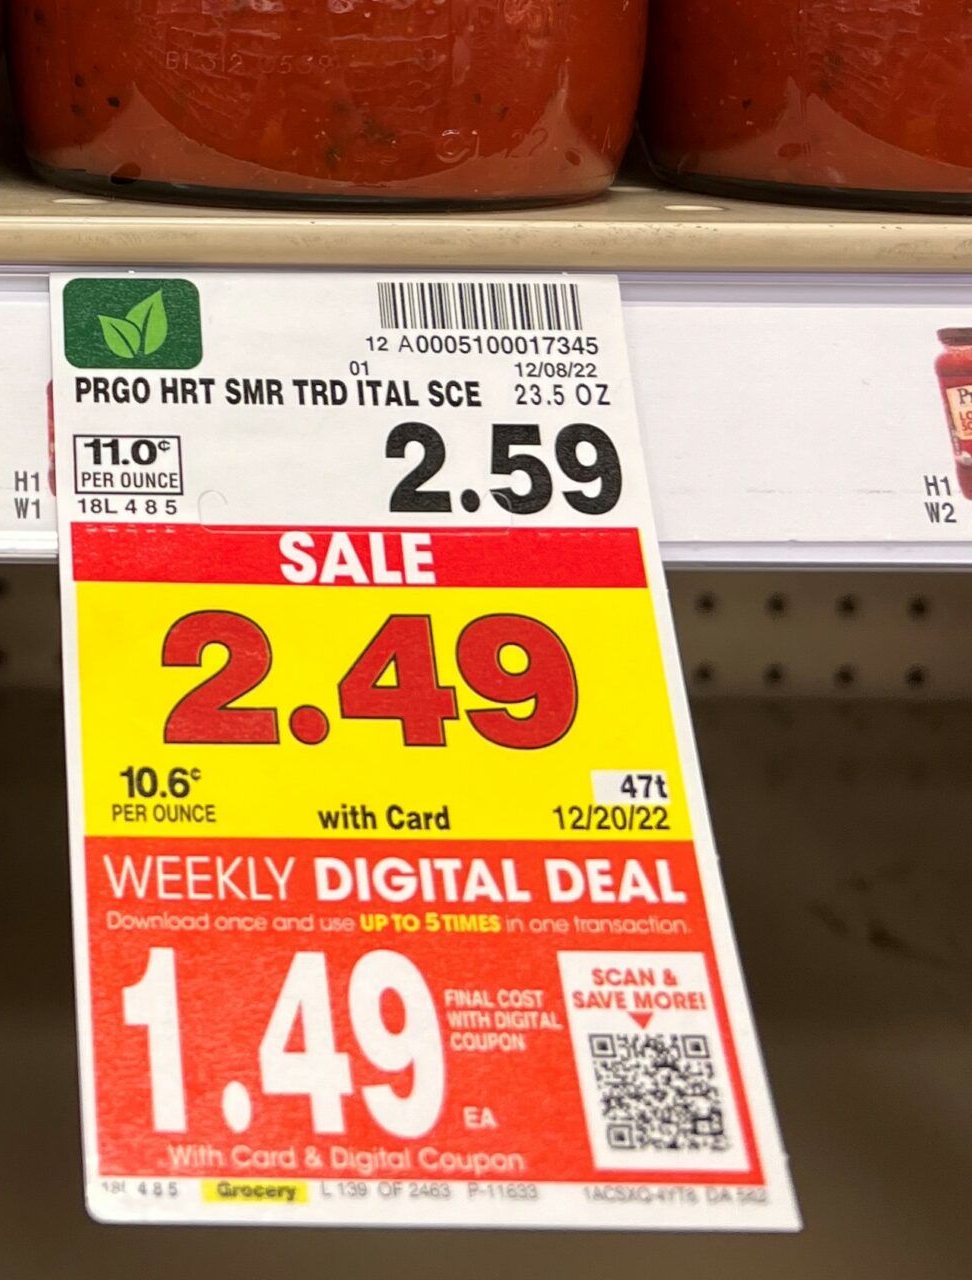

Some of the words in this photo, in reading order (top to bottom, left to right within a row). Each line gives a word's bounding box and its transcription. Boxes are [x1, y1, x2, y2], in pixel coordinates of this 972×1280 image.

[365, 337, 389, 353] 12
[397, 335, 599, 355] A0005100017345
[348, 361, 371, 377] 01
[513, 362, 598, 379] 12/08/22
[75, 377, 151, 405] PRGO
[160, 378, 216, 406] HRT
[224, 378, 285, 407] SMR
[293, 379, 348, 407] TRD
[357, 379, 421, 408] ITAL
[427, 380, 483, 409] SCE
[513, 384, 567, 406] 23.5
[576, 385, 612, 407] OZ
[383, 421, 624, 516] 2.59
[14, 471, 40, 492] H1
[81, 472, 114, 488] PER
[120, 472, 179, 489] OUNCE
[924, 475, 952, 497] H1
[14, 498, 41, 519] W1
[77, 498, 118, 514] 18L
[924, 502, 957, 523] W2
[278, 531, 437, 586] SALE
[161, 609, 578, 750] 2.49
[619, 773, 669, 799] 47t
[112, 804, 147, 822] PER
[152, 804, 216, 823] OUNCE
[317, 805, 378, 830] with
[386, 805, 452, 832] Card
[552, 805, 671, 832] 12/20/22
[103, 855, 297, 902] WEEKLY
[314, 857, 531, 904] DIGITAL
[543, 858, 687, 905] DEAL
[106, 910, 210, 930] Download
[214, 914, 268, 932] once
[272, 914, 315, 932] and
[320, 917, 356, 932] use
[360, 913, 388, 932] UP
[393, 914, 420, 932] TO
[442, 914, 501, 933] TIMES
[506, 916, 524, 934] in
[529, 917, 569, 934] one
[591, 968, 655, 987] SCAN
[663, 969, 677, 986] &
[444, 989, 494, 1008] FINAL
[497, 989, 544, 1009] COST
[572, 991, 627, 1010] SAVE
[635, 991, 707, 1010] MORE!
[447, 1010, 491, 1029] WITH
[494, 1012, 564, 1030] DIGITAL
[121, 946, 447, 1140] 1.49
[450, 1032, 525, 1052] COUPON
[462, 1106, 498, 1129] EA
[166, 1143, 224, 1169] With
[231, 1144, 297, 1170] Card
[303, 1145, 324, 1170] &
[330, 1145, 410, 1176] Digital
[417, 1146, 524, 1174] Coupon
[216, 1182, 297, 1202] Grocery
